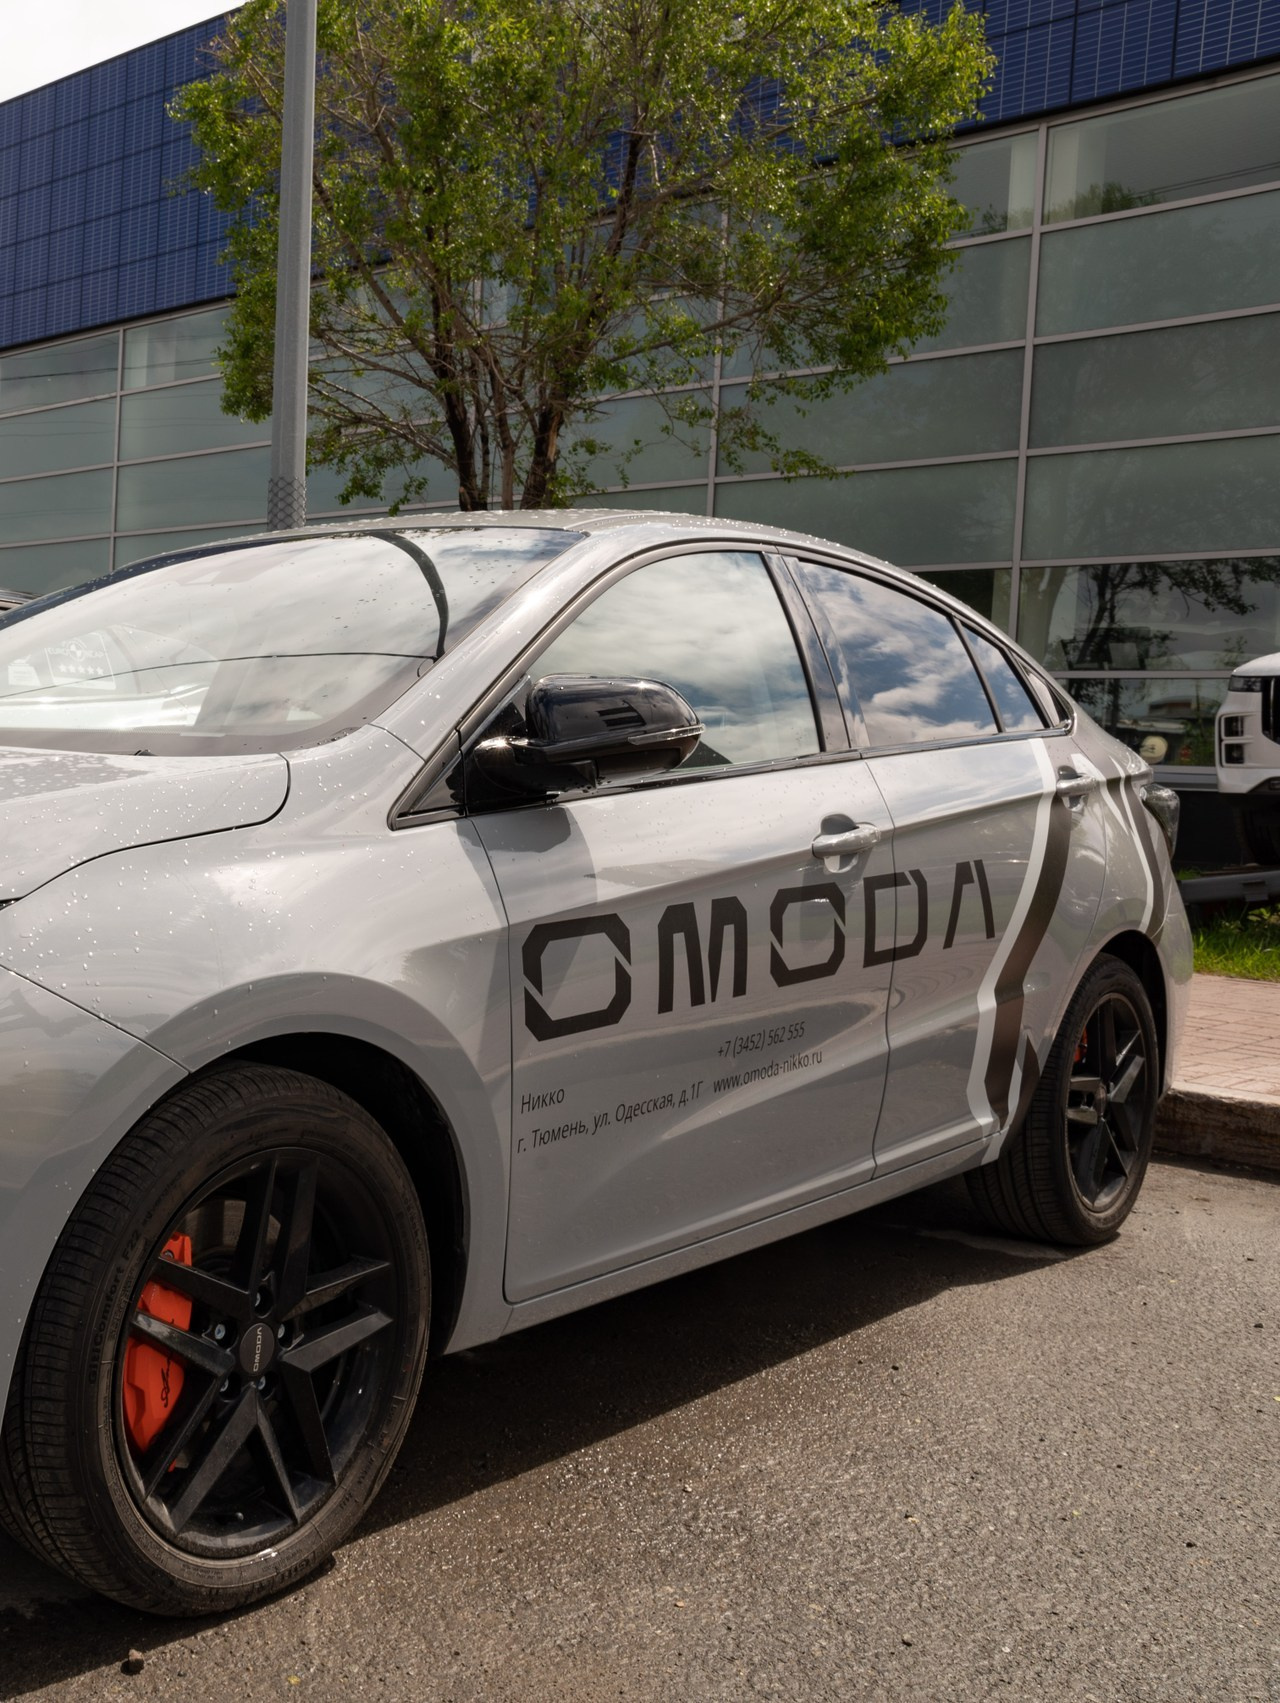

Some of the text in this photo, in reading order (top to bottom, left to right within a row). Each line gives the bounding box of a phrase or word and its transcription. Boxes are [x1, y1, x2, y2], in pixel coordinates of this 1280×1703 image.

[522, 859, 996, 1041] OMODA
[717, 1021, 805, 1058] +7 (3452) 562 555
[713, 1049, 823, 1094] www.omoda-nikko.ru
[517, 1137, 527, 1154] г.
[532, 1119, 589, 1150] Тюмень,
[592, 1111, 611, 1135] ул.
[615, 1091, 676, 1123] Одесская,
[521, 1088, 565, 1114] Никко
[252, 1326, 263, 1373] OMODA
